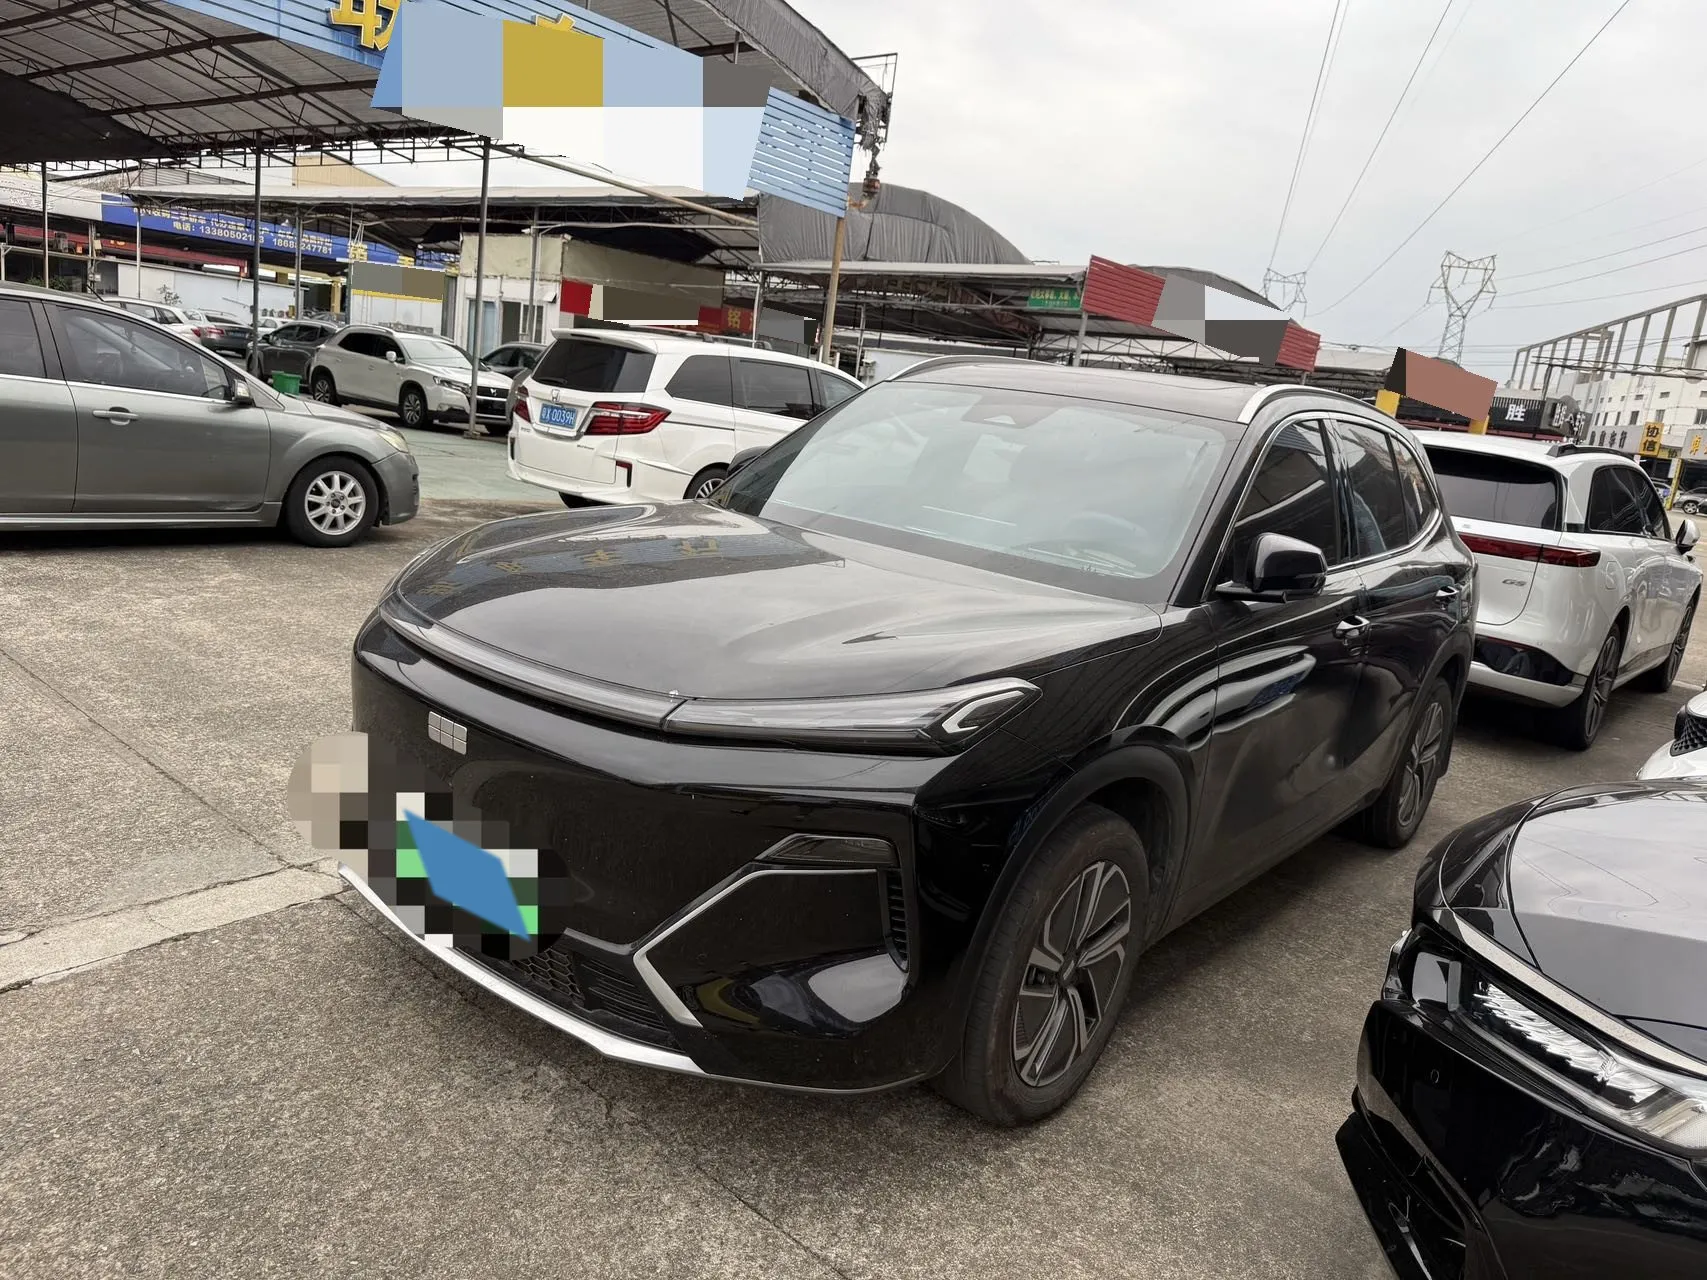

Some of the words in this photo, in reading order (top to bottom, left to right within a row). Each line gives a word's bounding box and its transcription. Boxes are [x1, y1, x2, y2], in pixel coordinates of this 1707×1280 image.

[200, 226, 264, 243] 1338050213
[273, 238, 332, 255] 1868247781
[1505, 404, 1526, 421] 胜
[1643, 425, 1660, 452] 协信
